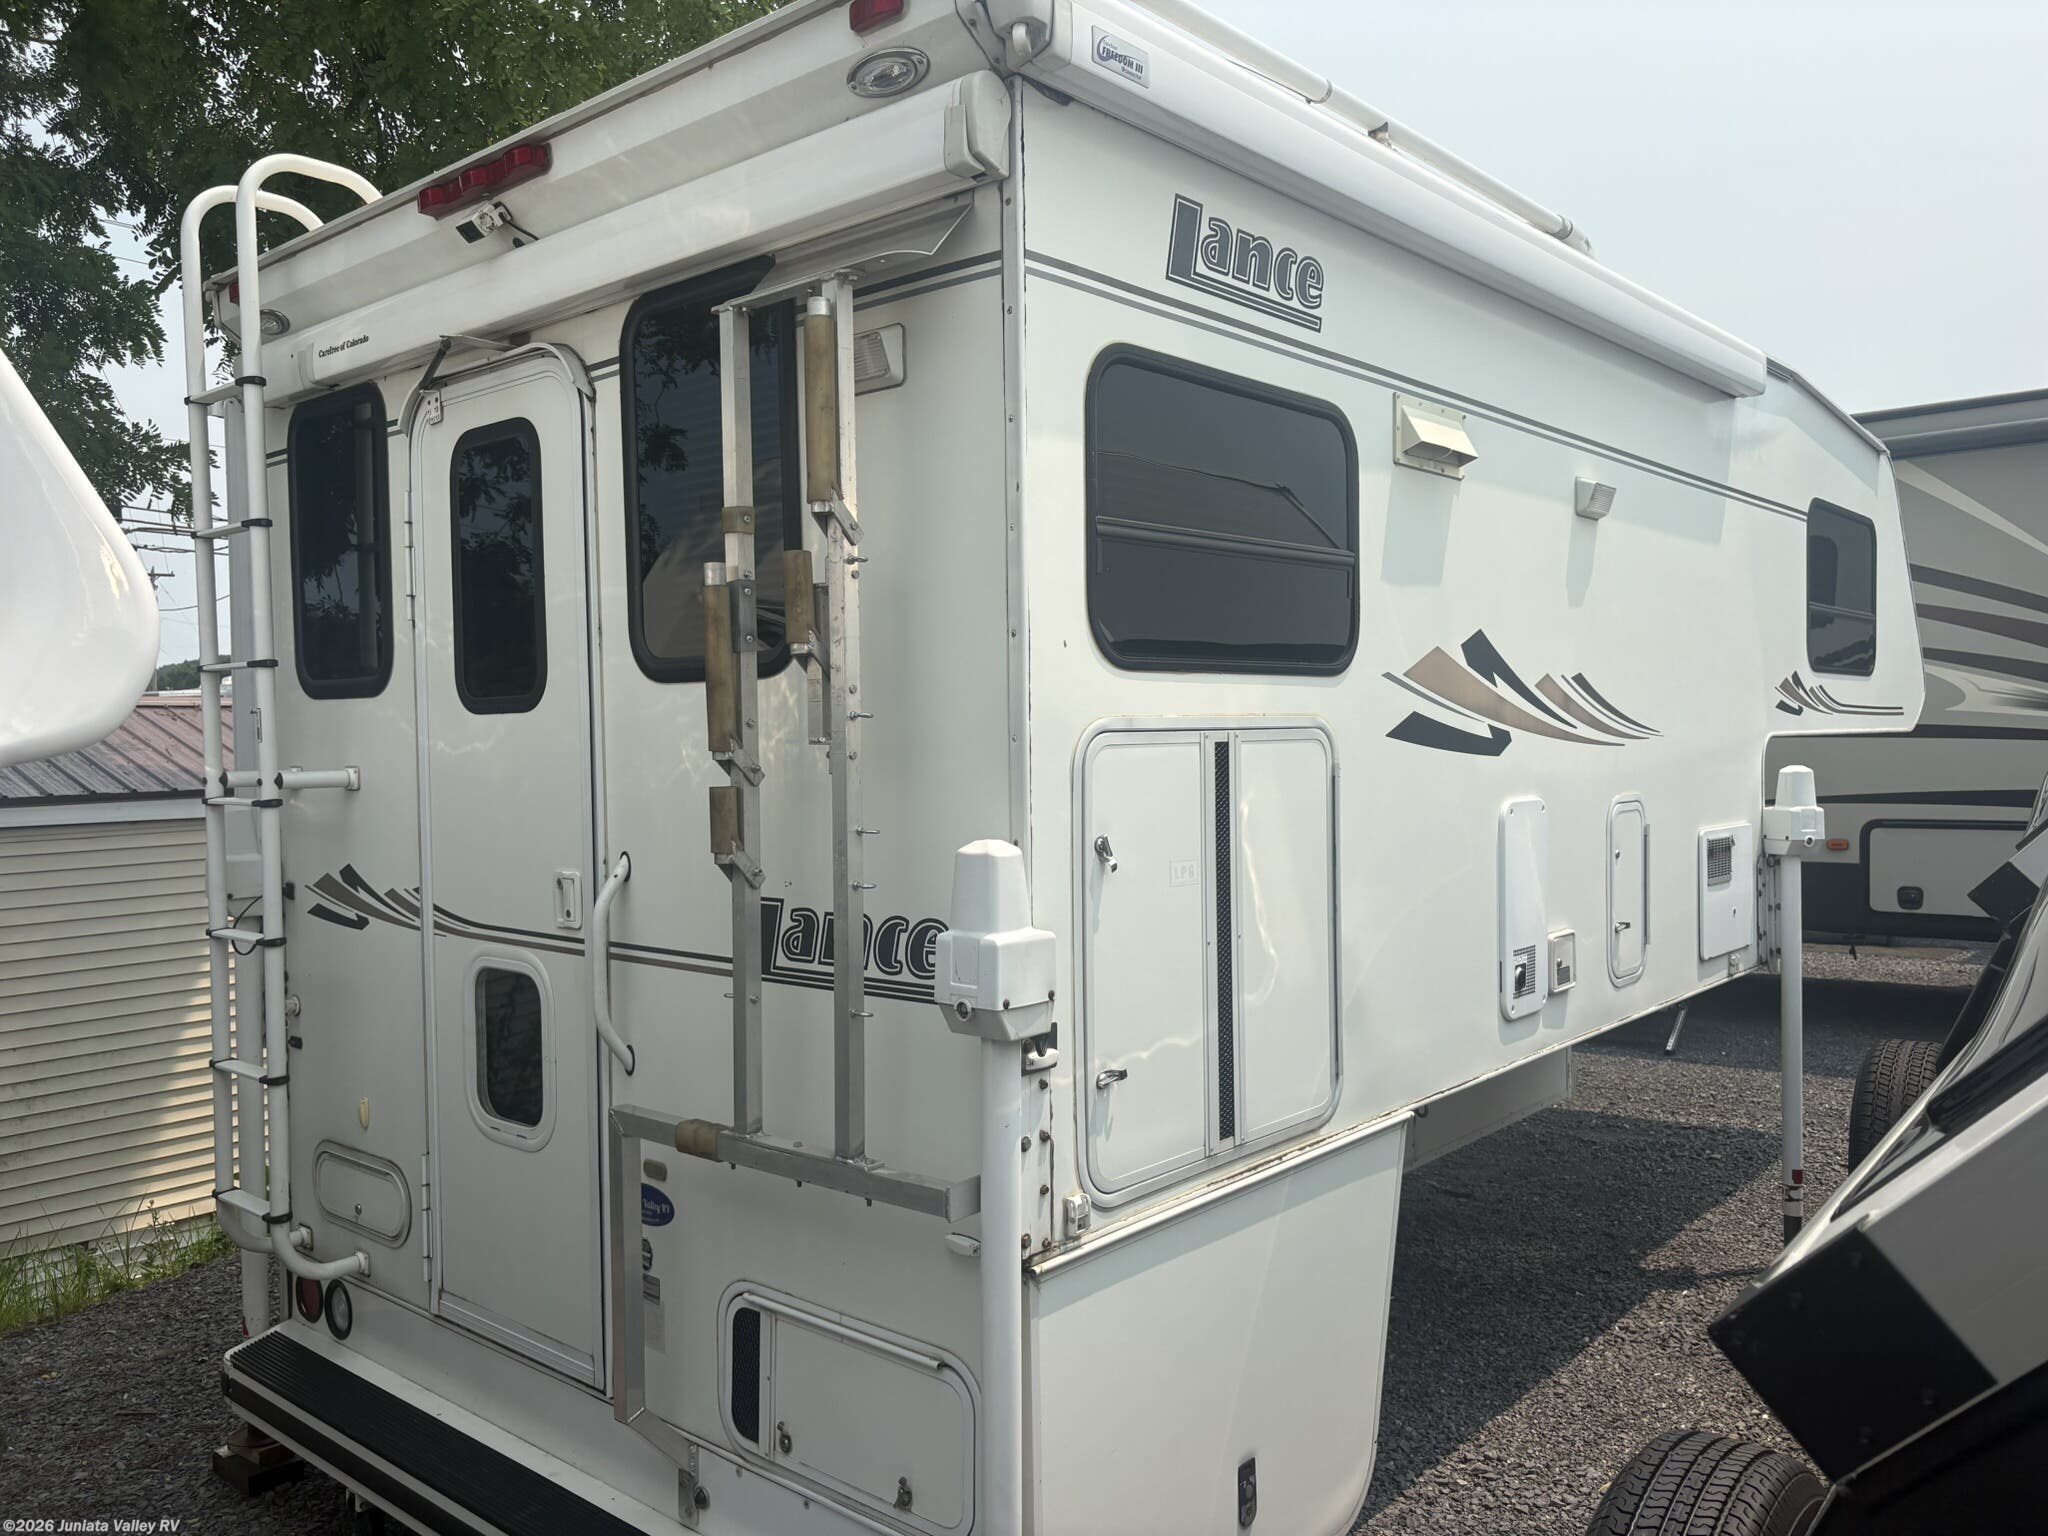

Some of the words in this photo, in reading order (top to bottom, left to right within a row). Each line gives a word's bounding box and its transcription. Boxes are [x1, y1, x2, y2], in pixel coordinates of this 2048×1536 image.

[1101, 46, 1134, 70] FREEDOM
[1135, 62, 1144, 75] III
[1166, 193, 1324, 333] Lance
[340, 341, 346, 351] of
[346, 334, 369, 349] Colorado
